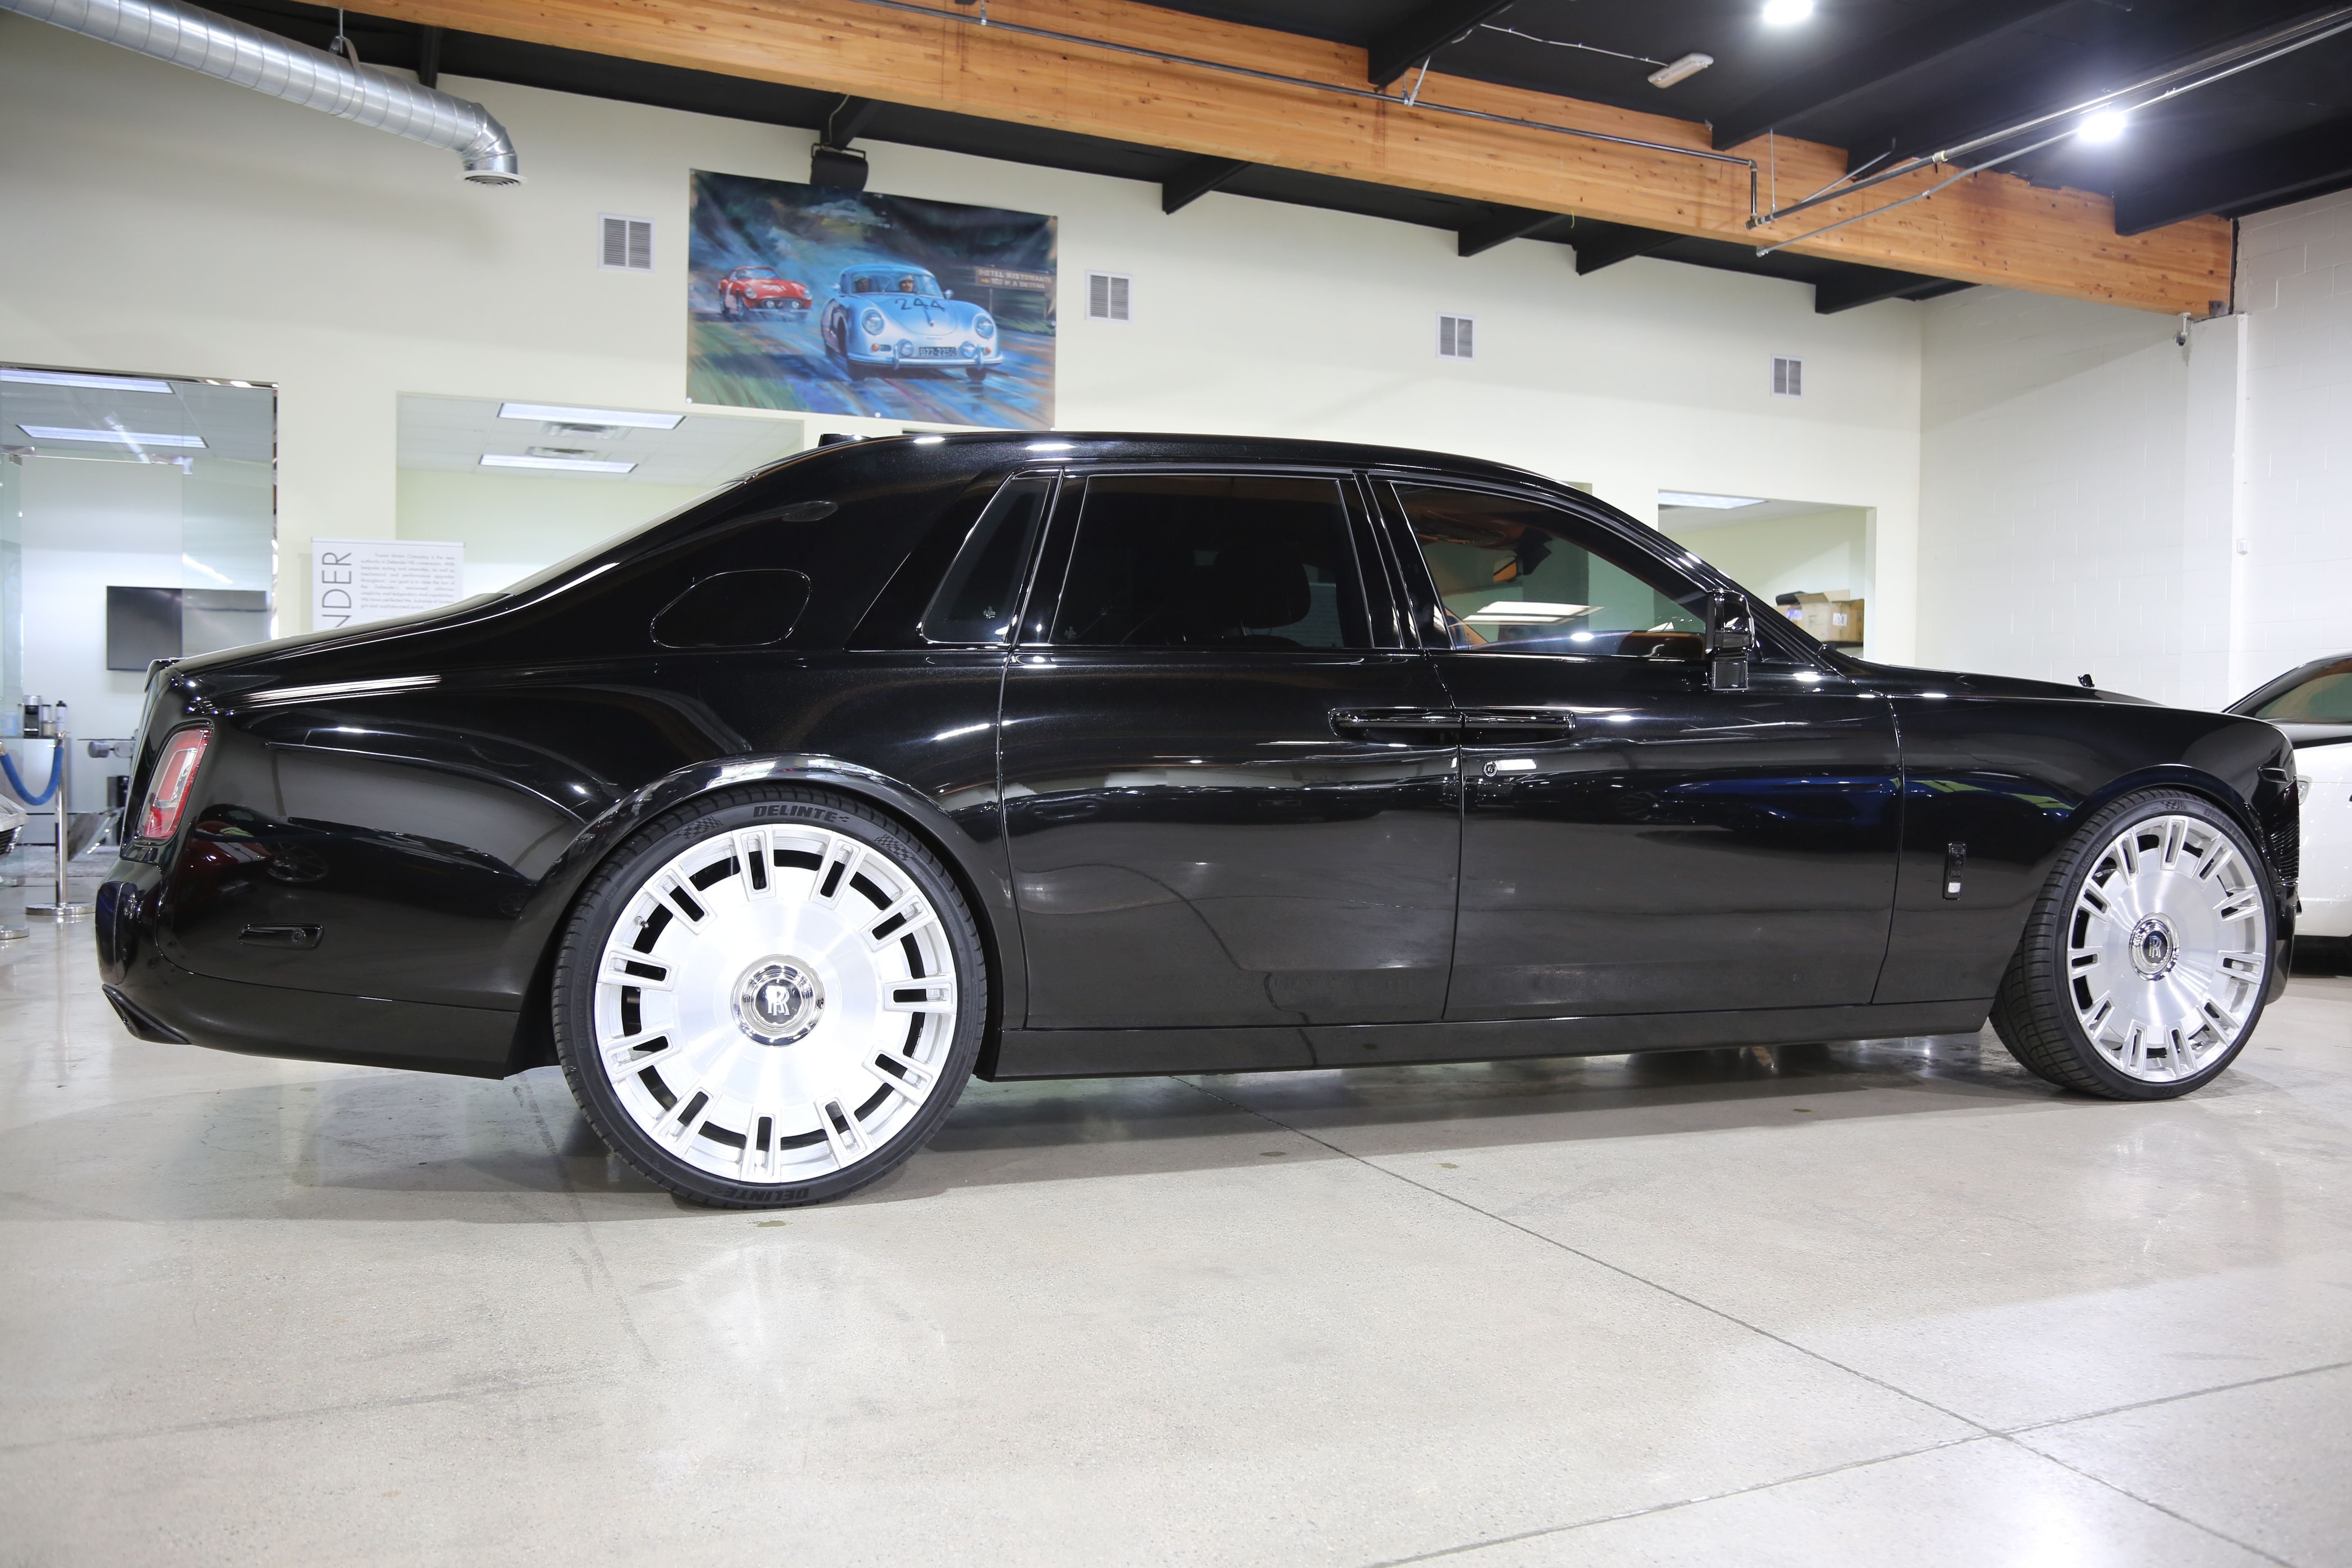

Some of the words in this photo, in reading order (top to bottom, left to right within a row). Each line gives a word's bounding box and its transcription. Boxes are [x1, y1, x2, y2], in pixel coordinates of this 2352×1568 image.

[978, 269, 1004, 278] HOTEL
[894, 298, 946, 312] 244
[753, 804, 838, 823] DELINTE
[2076, 843, 2100, 875] Storm
[722, 1187, 811, 1203] DELINTE
